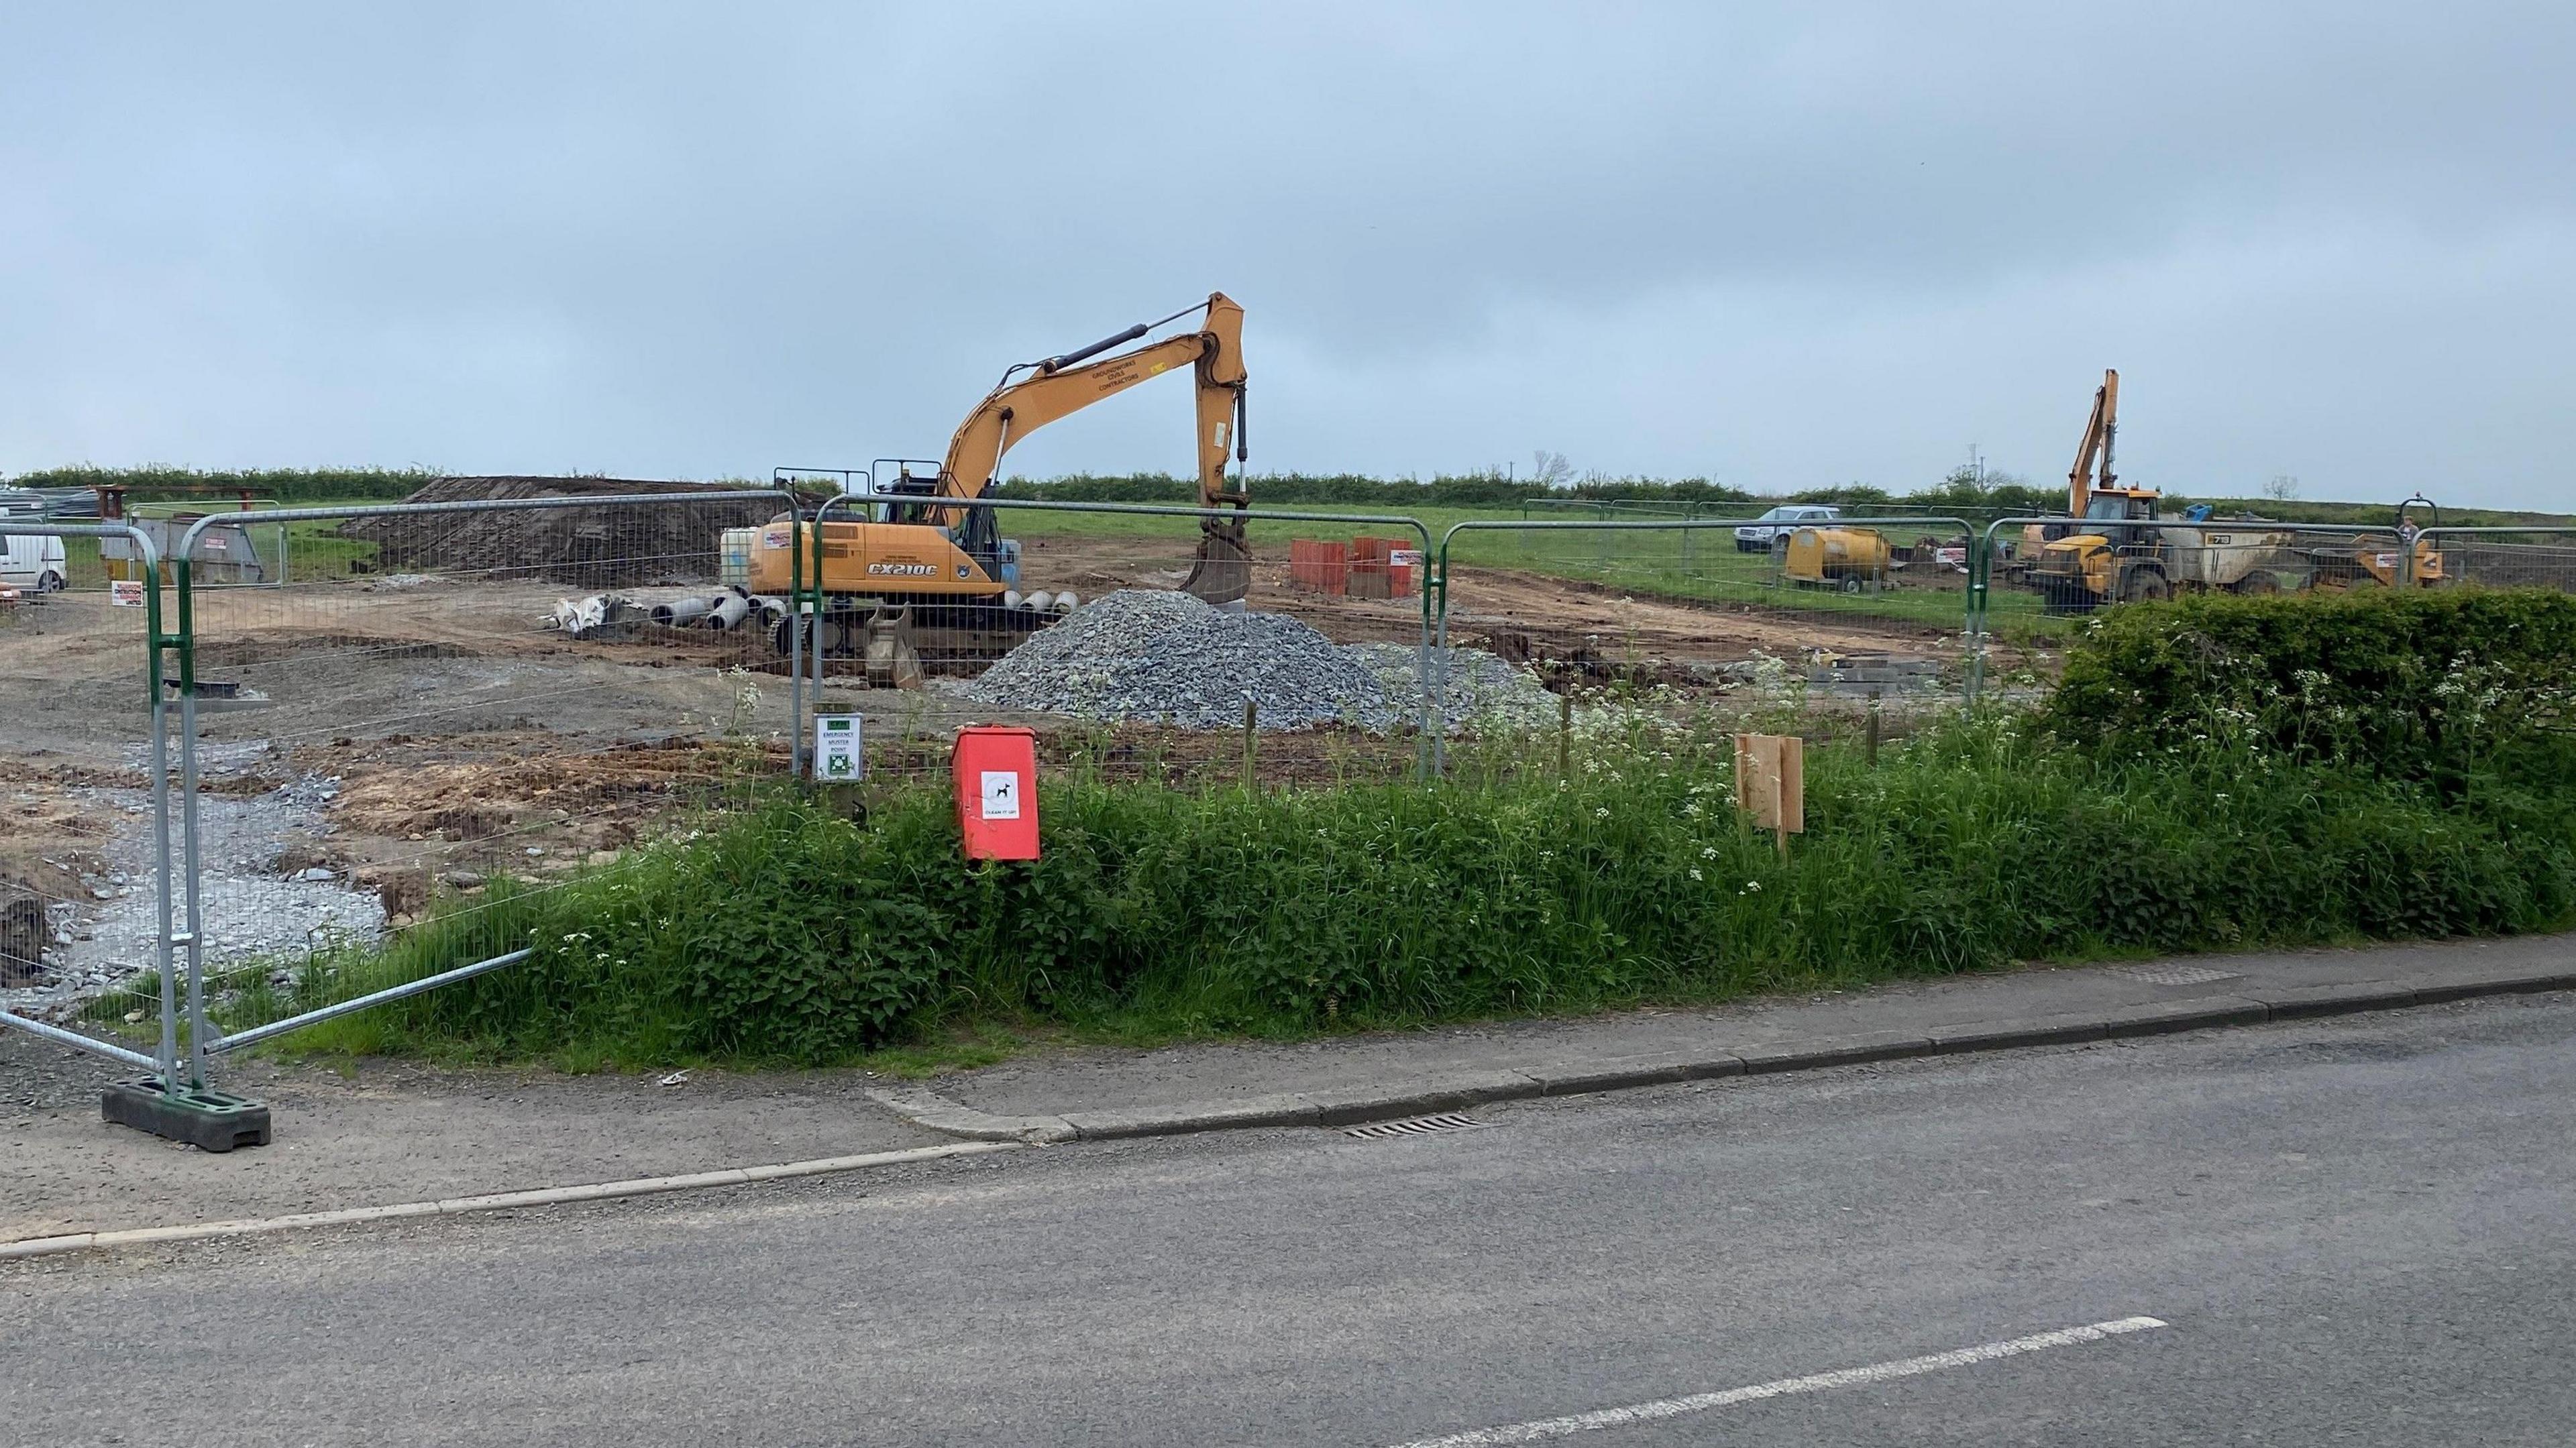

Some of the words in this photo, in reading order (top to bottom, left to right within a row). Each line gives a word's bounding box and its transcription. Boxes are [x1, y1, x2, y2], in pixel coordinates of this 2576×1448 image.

[1092, 359, 1136, 379] GROUNDWORKS
[1099, 373, 1139, 392] CONTRACTORS
[867, 563, 938, 575] CX210C
